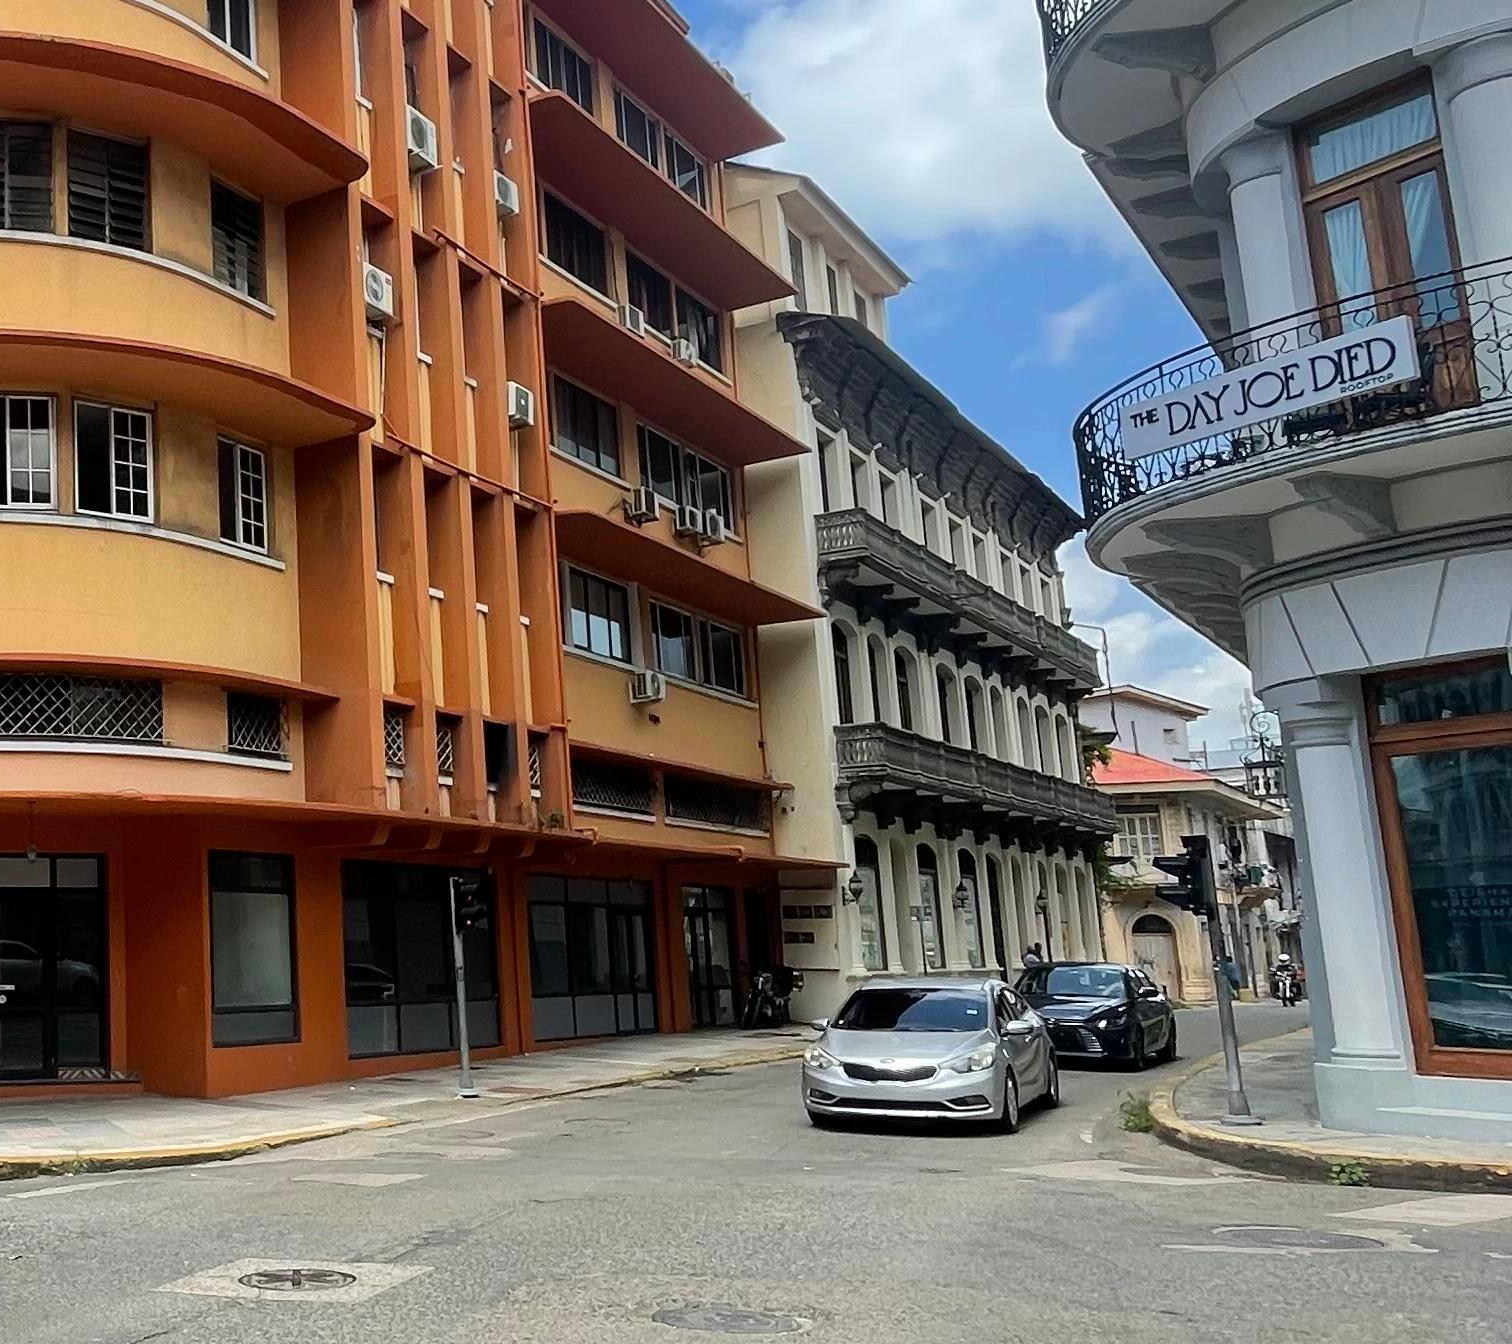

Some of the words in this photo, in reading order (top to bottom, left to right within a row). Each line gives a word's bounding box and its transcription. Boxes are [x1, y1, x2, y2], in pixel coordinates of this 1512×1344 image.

[1129, 407, 1160, 429] THE
[1165, 384, 1230, 436] DAY
[1233, 363, 1304, 416] JOE
[1308, 337, 1397, 393] DIED
[1340, 372, 1394, 394] ROOFTOP
